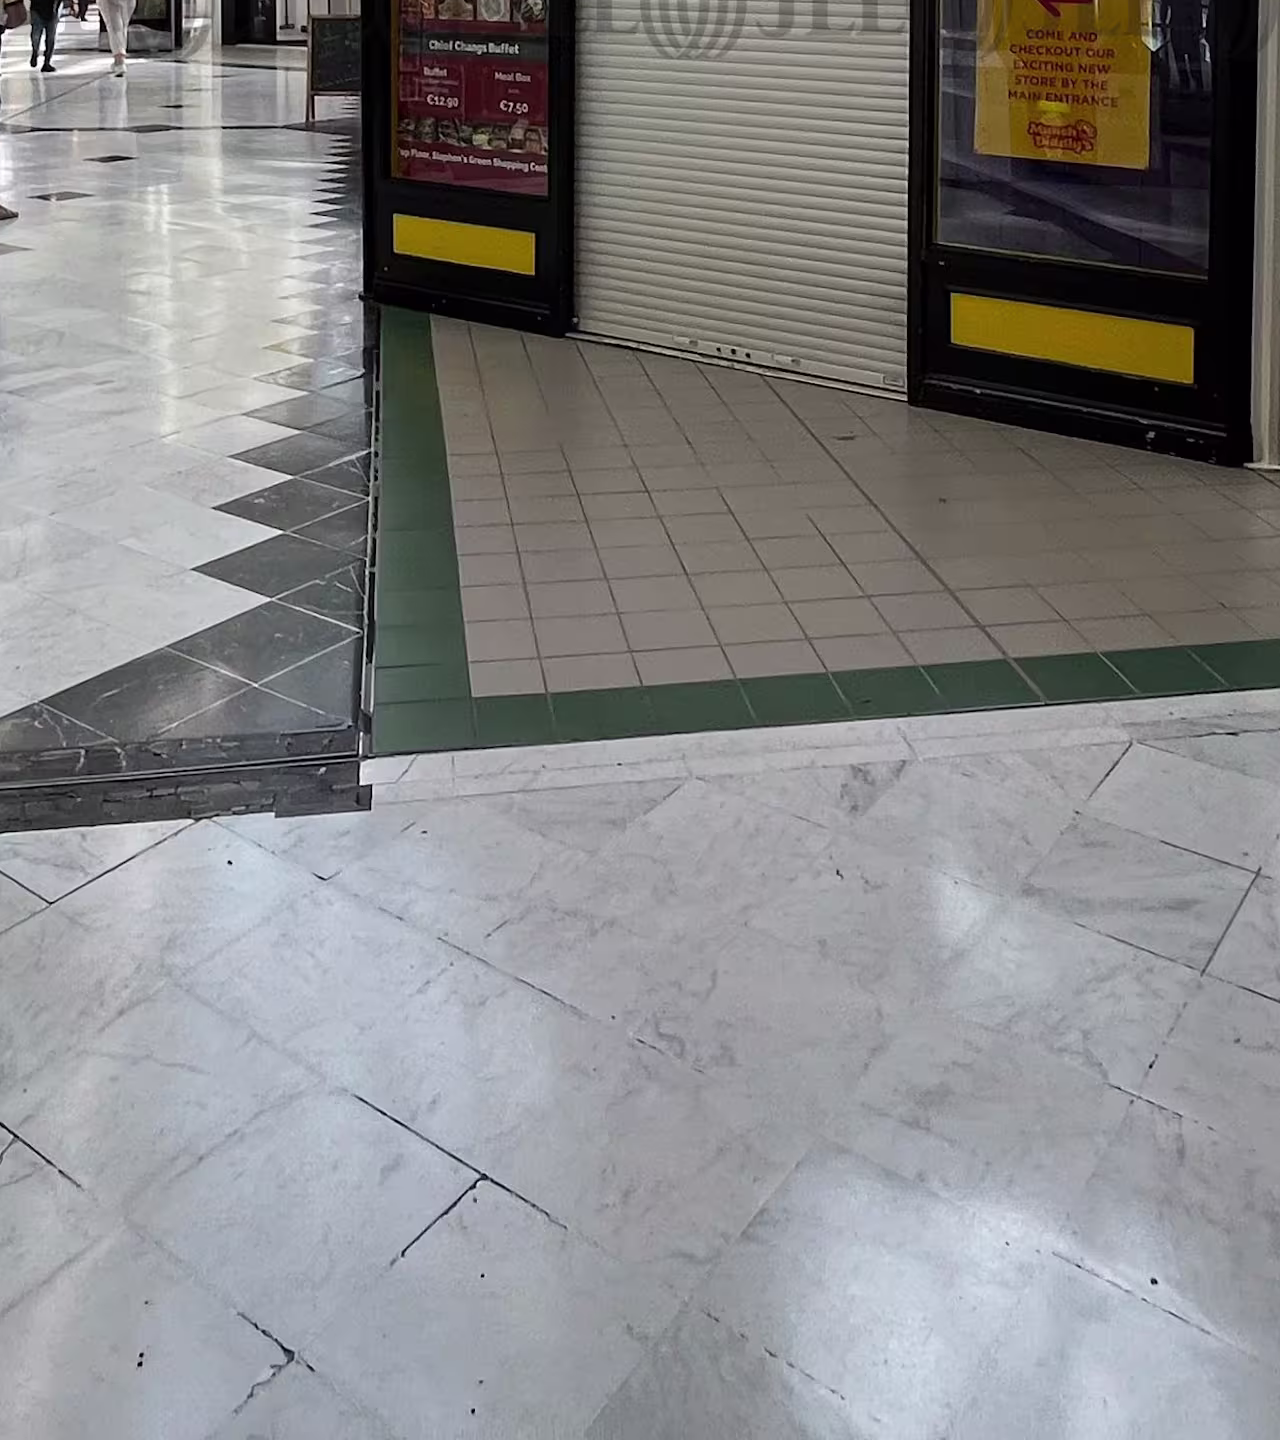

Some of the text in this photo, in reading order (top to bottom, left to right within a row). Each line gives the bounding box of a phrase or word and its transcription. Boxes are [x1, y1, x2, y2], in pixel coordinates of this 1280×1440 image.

[1026, 29, 1098, 42] COME AND
[429, 40, 520, 55] Chief Changs Buffet
[1009, 44, 1116, 59] CHECKOUT OUR
[1013, 59, 1111, 75] EXCITING NEW
[495, 71, 532, 83] Meal Box
[1015, 75, 1108, 91] STORE BY THE
[427, 94, 459, 108] €12.90
[1008, 89, 1119, 108] MAIN ENTRANCE
[499, 100, 529, 114] €7.50
[469, 155, 492, 166] Green
[493, 157, 529, 173] Shopping
